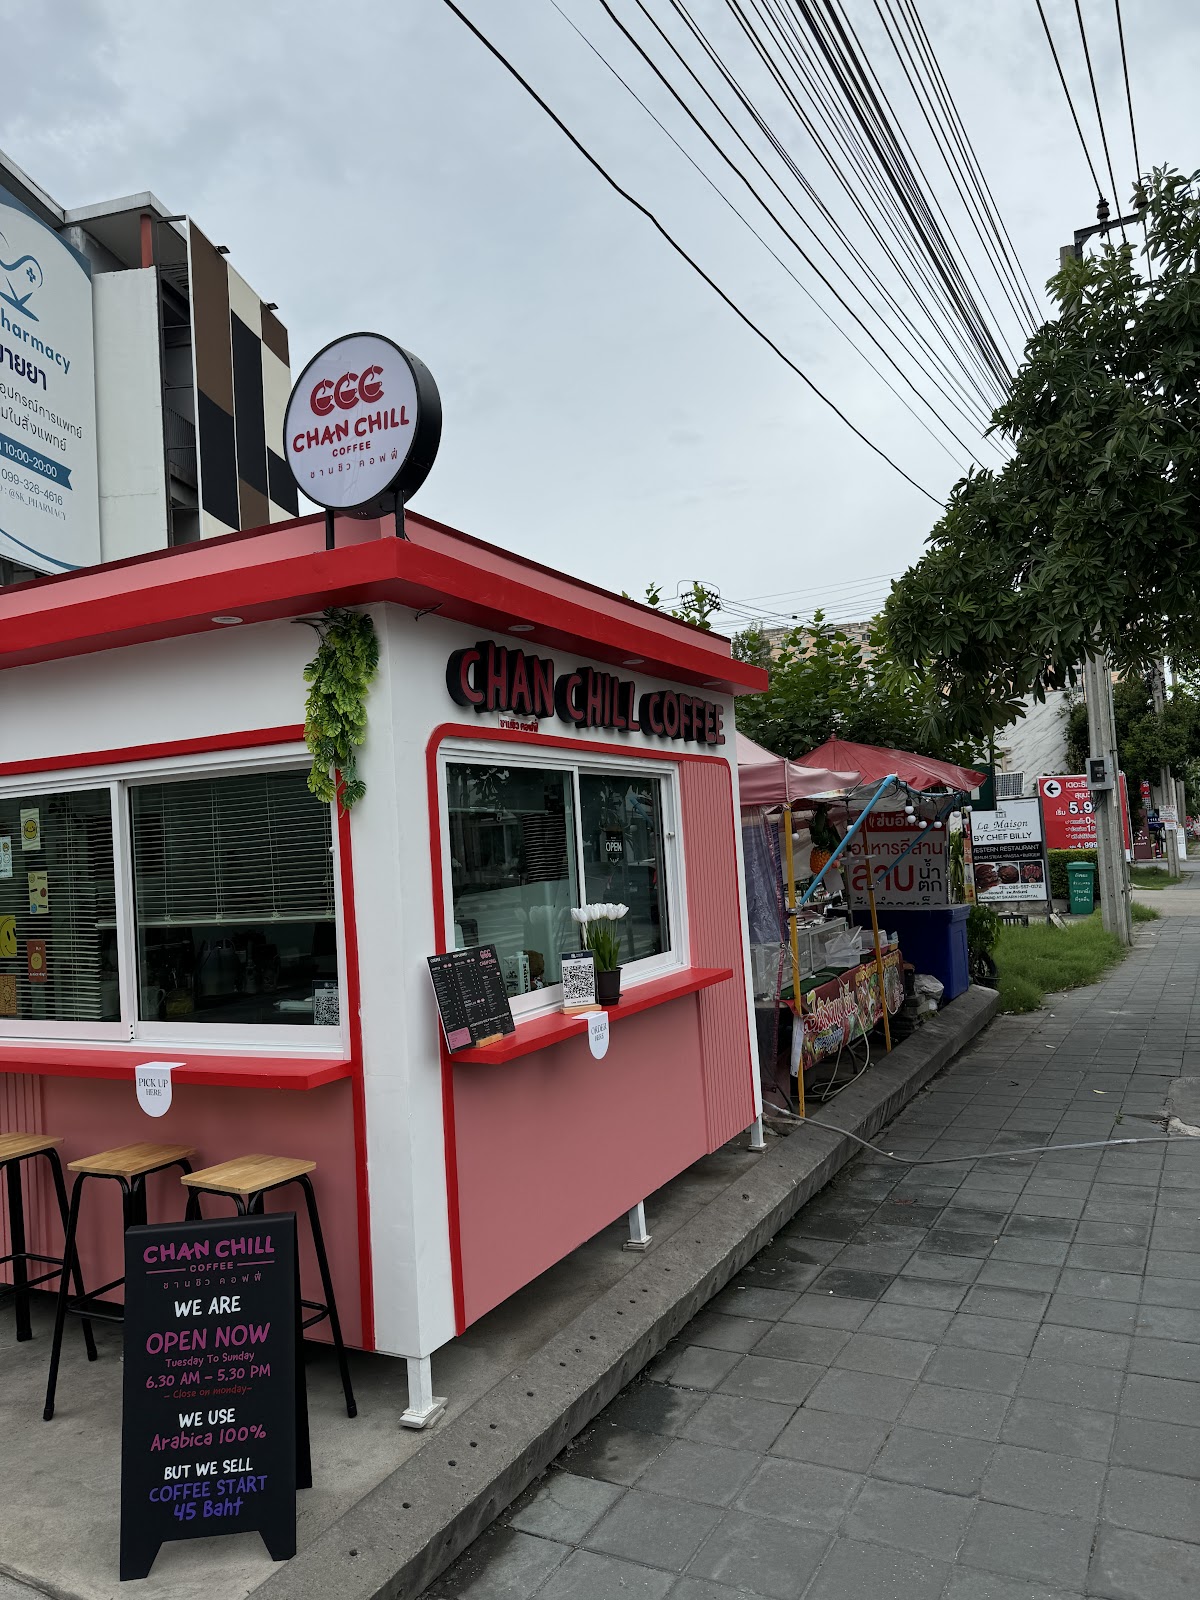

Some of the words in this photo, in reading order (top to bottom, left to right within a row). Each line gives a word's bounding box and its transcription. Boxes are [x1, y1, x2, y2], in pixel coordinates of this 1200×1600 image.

[0, 308, 70, 374] harmacy
[293, 420, 348, 452] CHAN
[354, 405, 409, 436] CHILL
[4, 442, 57, 477] 10:00-20:00
[332, 441, 371, 457] COFFEE
[1, 468, 63, 505] 099-326-4616
[450, 640, 554, 718] CHAN
[558, 666, 640, 732] CHILL
[642, 690, 725, 745] COFFEE
[1069, 801, 1095, 814] 5.9
[977, 822, 989, 830] La
[993, 820, 1028, 828] Maison
[606, 842, 622, 852] OPEN
[1000, 844, 1040, 852] RESTAURANT
[138, 1078, 156, 1087] PICK
[158, 1078, 168, 1088] UP
[143, 1240, 210, 1263] CHAN
[215, 1236, 275, 1258] CHILL
[189, 1262, 234, 1272] COFFEE
[174, 1299, 202, 1318] WE
[208, 1295, 241, 1315] ARE
[146, 1328, 207, 1354] OPEN
[215, 1322, 270, 1348] NOW
[165, 1356, 204, 1368] Tuesday
[207, 1354, 219, 1365] To
[222, 1351, 254, 1362] Sunday
[146, 1375, 175, 1389] 6.30
[180, 1371, 200, 1385] AM
[217, 1368, 245, 1382] 5.30
[250, 1363, 271, 1379] PM
[173, 1389, 196, 1399] Close
[178, 1411, 203, 1428] WE
[208, 1408, 236, 1425] USE
[150, 1431, 213, 1452] Arabica
[219, 1424, 267, 1444] 100%
[164, 1464, 191, 1480] BUT
[195, 1461, 218, 1477] WE
[222, 1457, 253, 1474] SELL
[149, 1481, 211, 1502] COFFEE
[217, 1475, 268, 1496] START
[173, 1502, 197, 1521] 45
[203, 1496, 243, 1518] Baht
